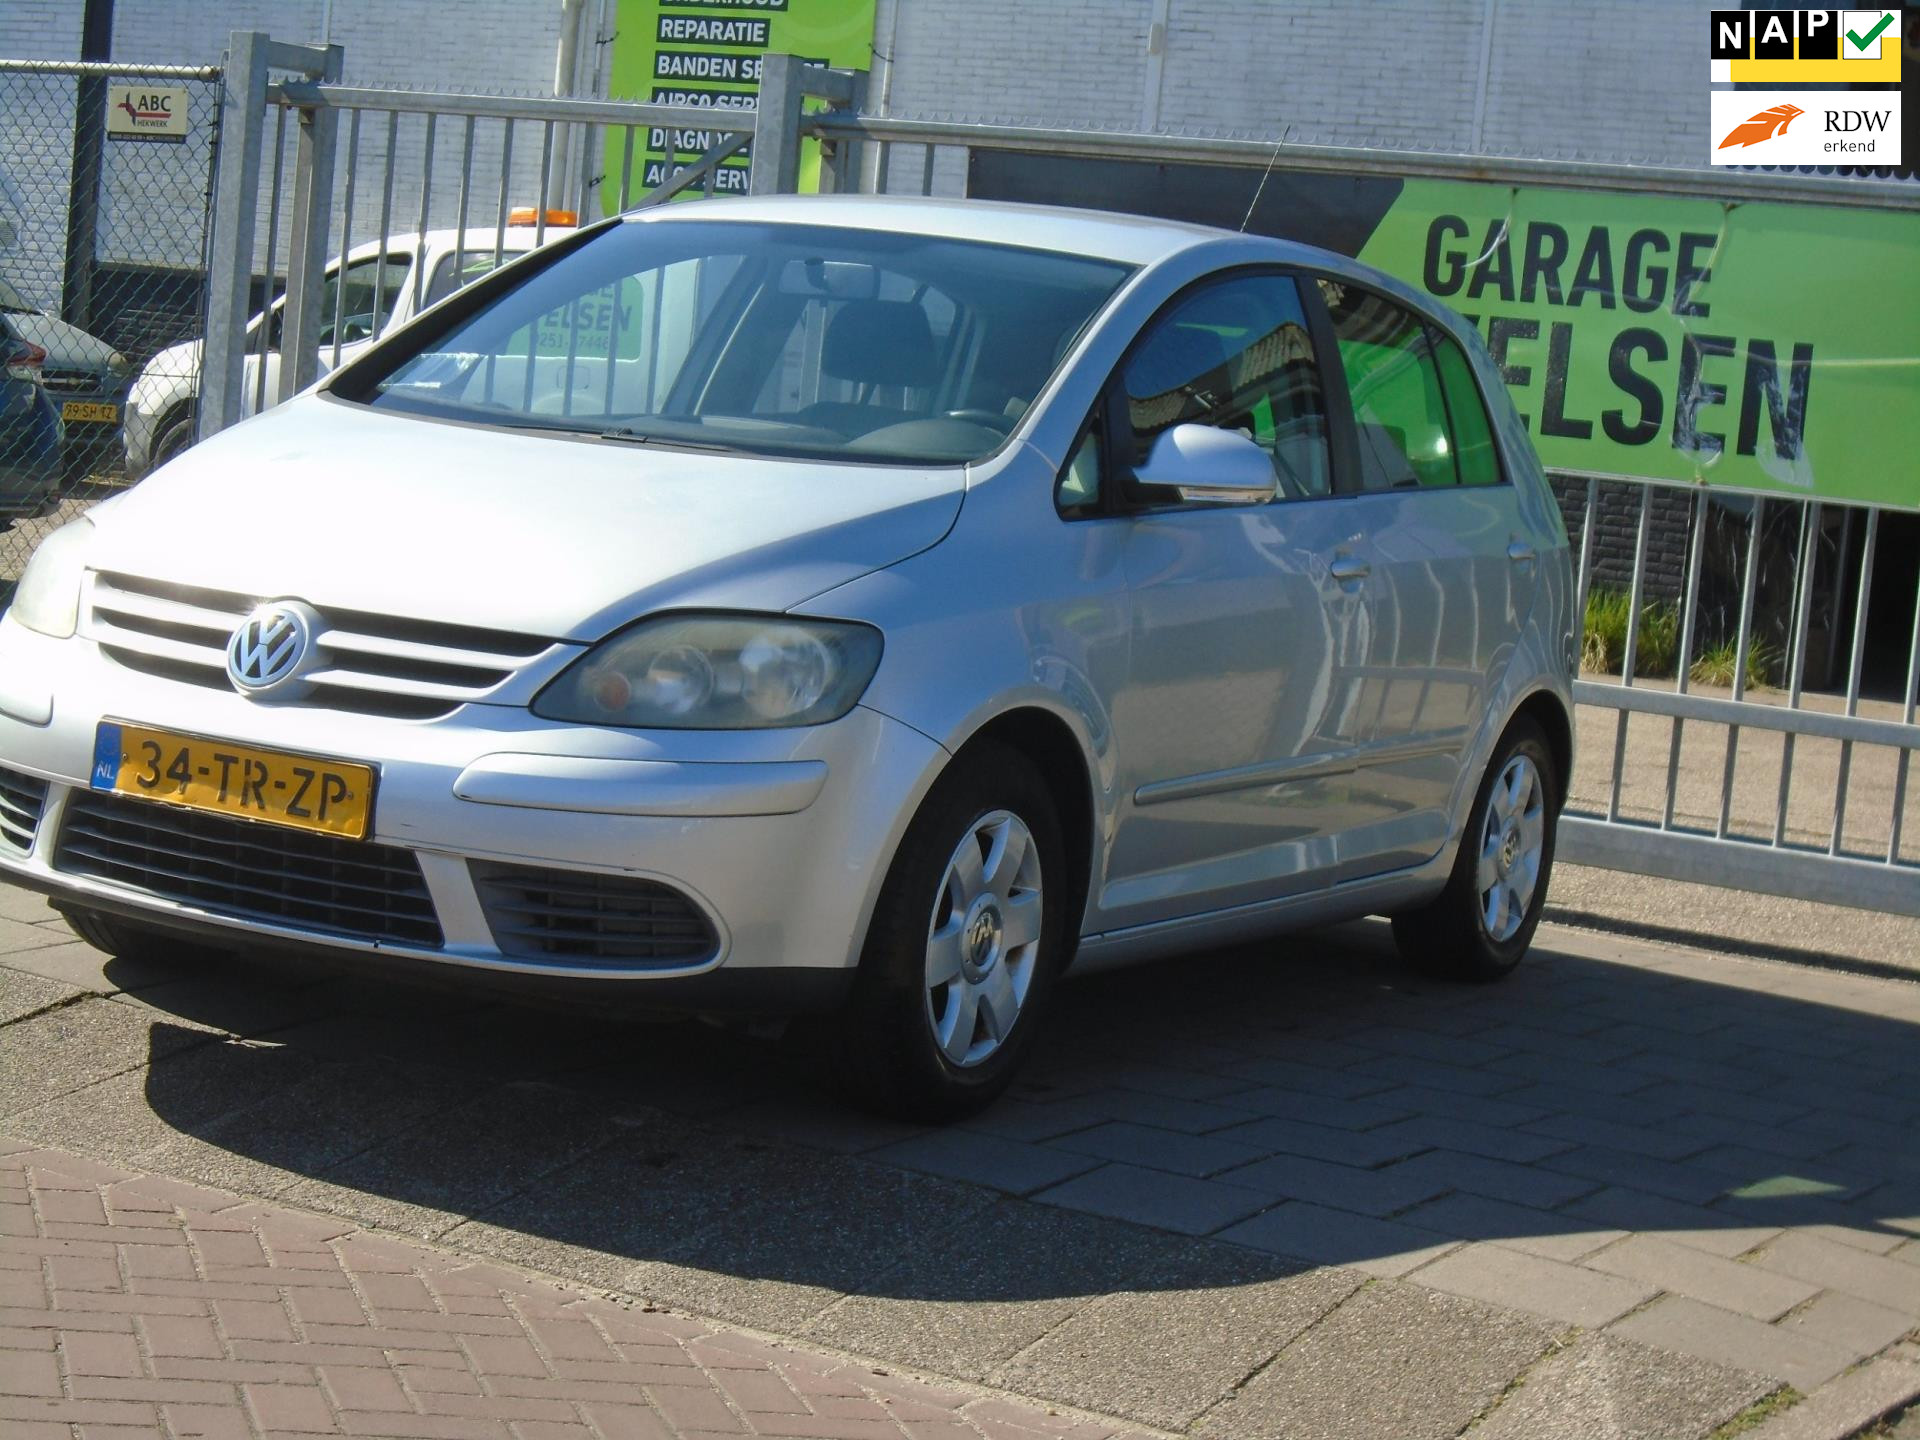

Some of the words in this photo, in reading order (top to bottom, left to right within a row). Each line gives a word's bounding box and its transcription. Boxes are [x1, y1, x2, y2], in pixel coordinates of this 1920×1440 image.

[660, 18, 766, 42] REPARATIE
[657, 55, 737, 78] BANDEN
[137, 94, 172, 112] ABC
[137, 120, 168, 128] HEKWERK
[1423, 215, 1719, 318] GARAGE
[1463, 312, 1815, 461] ELSEN
[96, 759, 115, 780] NL
[136, 740, 347, 821] 34-TR-ZP
